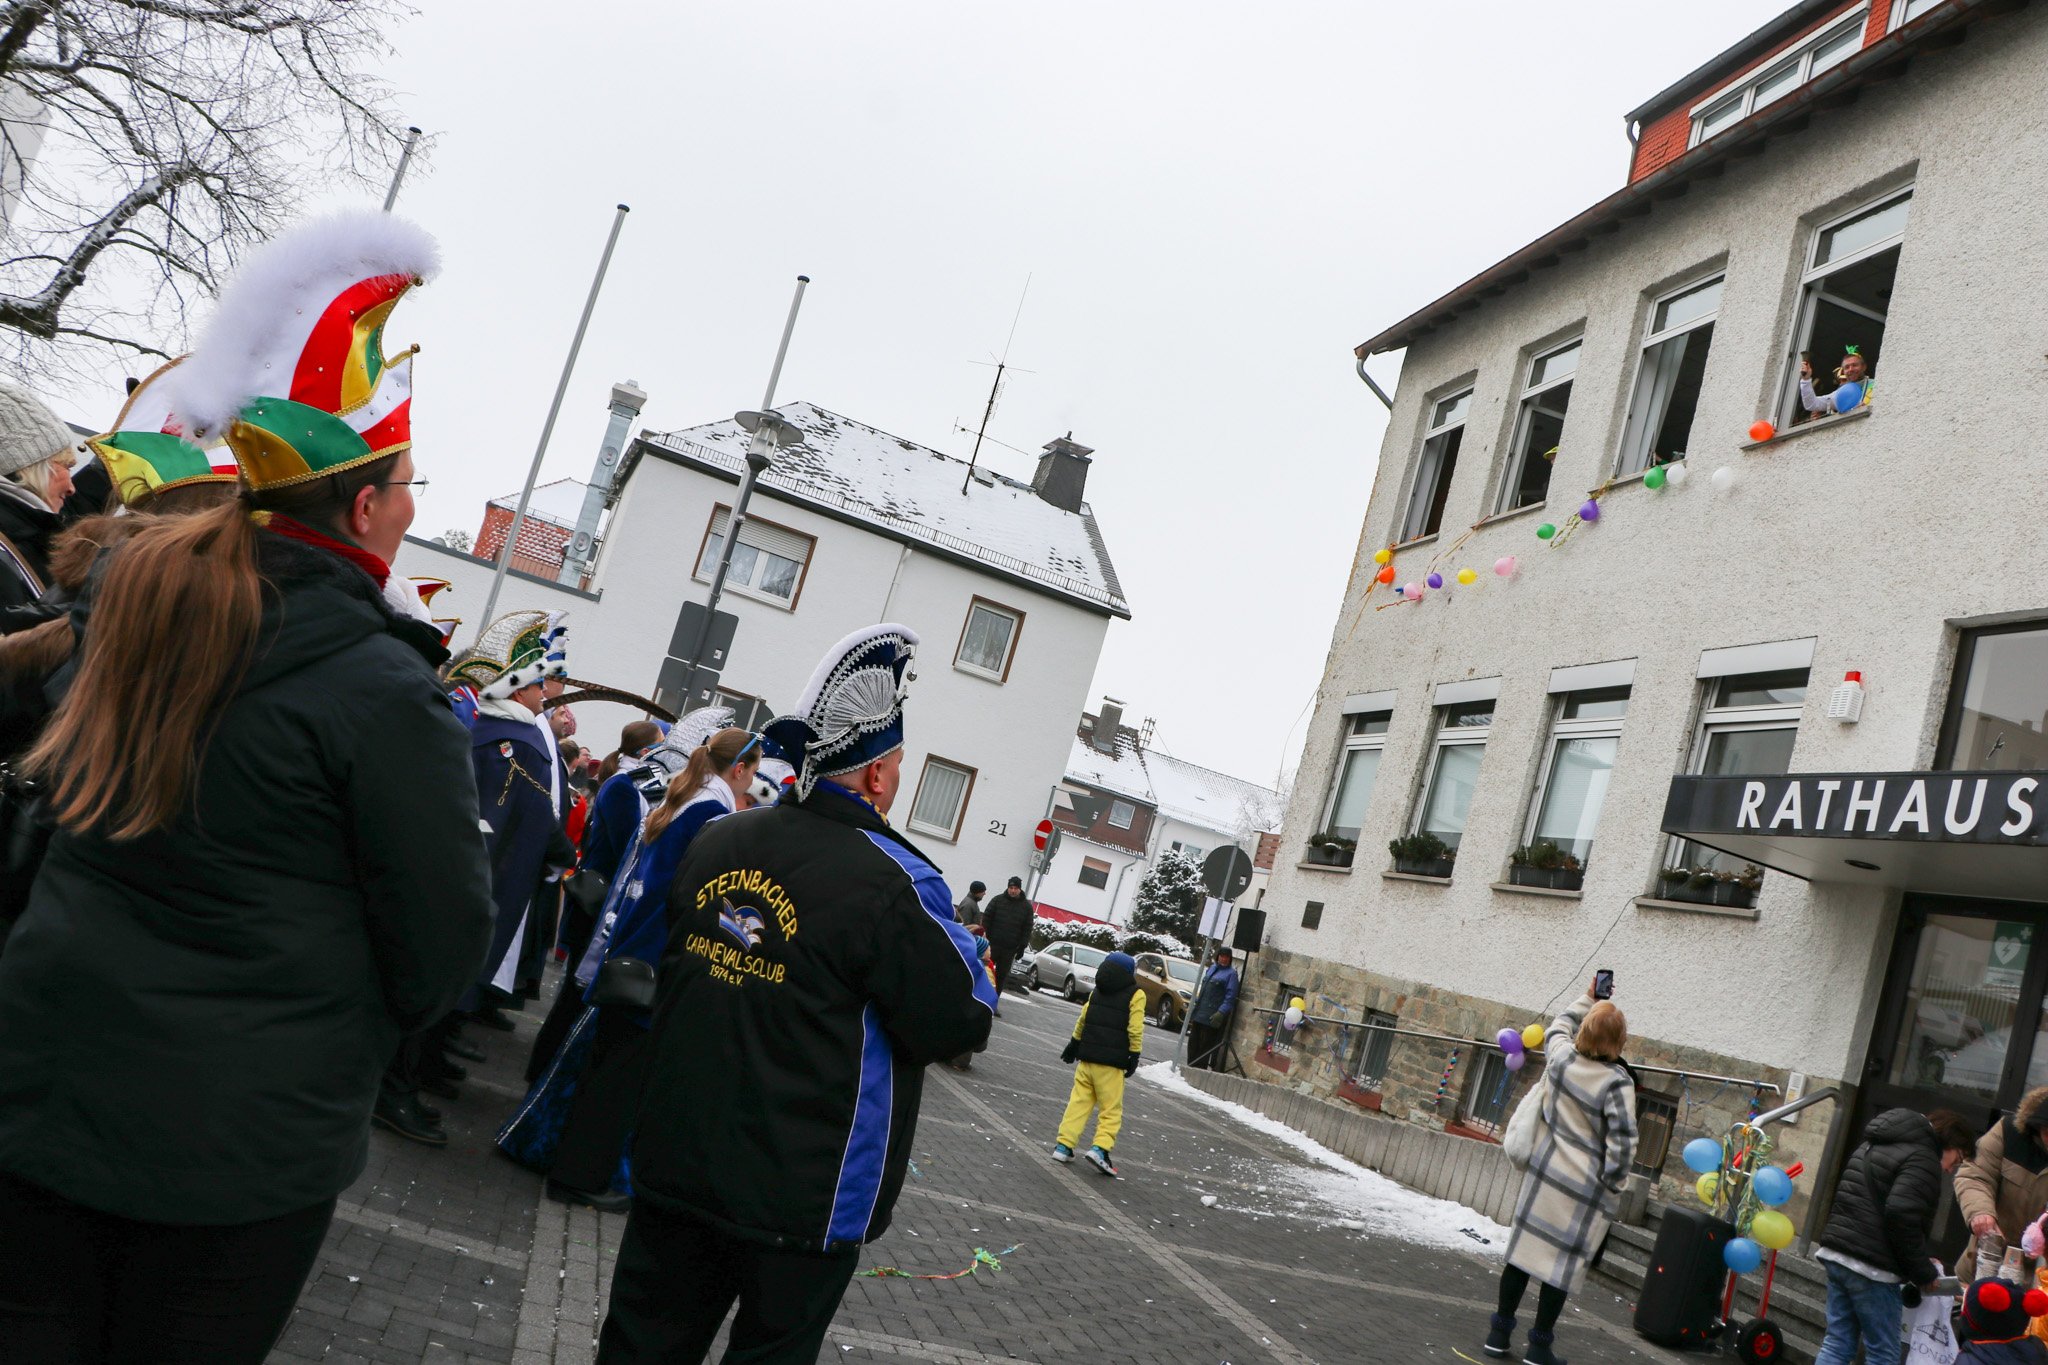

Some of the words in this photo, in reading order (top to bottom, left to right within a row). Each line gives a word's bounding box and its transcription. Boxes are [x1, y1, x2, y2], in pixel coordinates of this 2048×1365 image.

[988, 819, 1007, 837] 21
[1736, 777, 2039, 836] RATHAUS
[696, 869, 798, 942] STEINBACHER
[686, 933, 785, 983] CARNEVALSCLUB
[709, 964, 729, 981] 1974
[728, 972, 743, 988] e.V.
